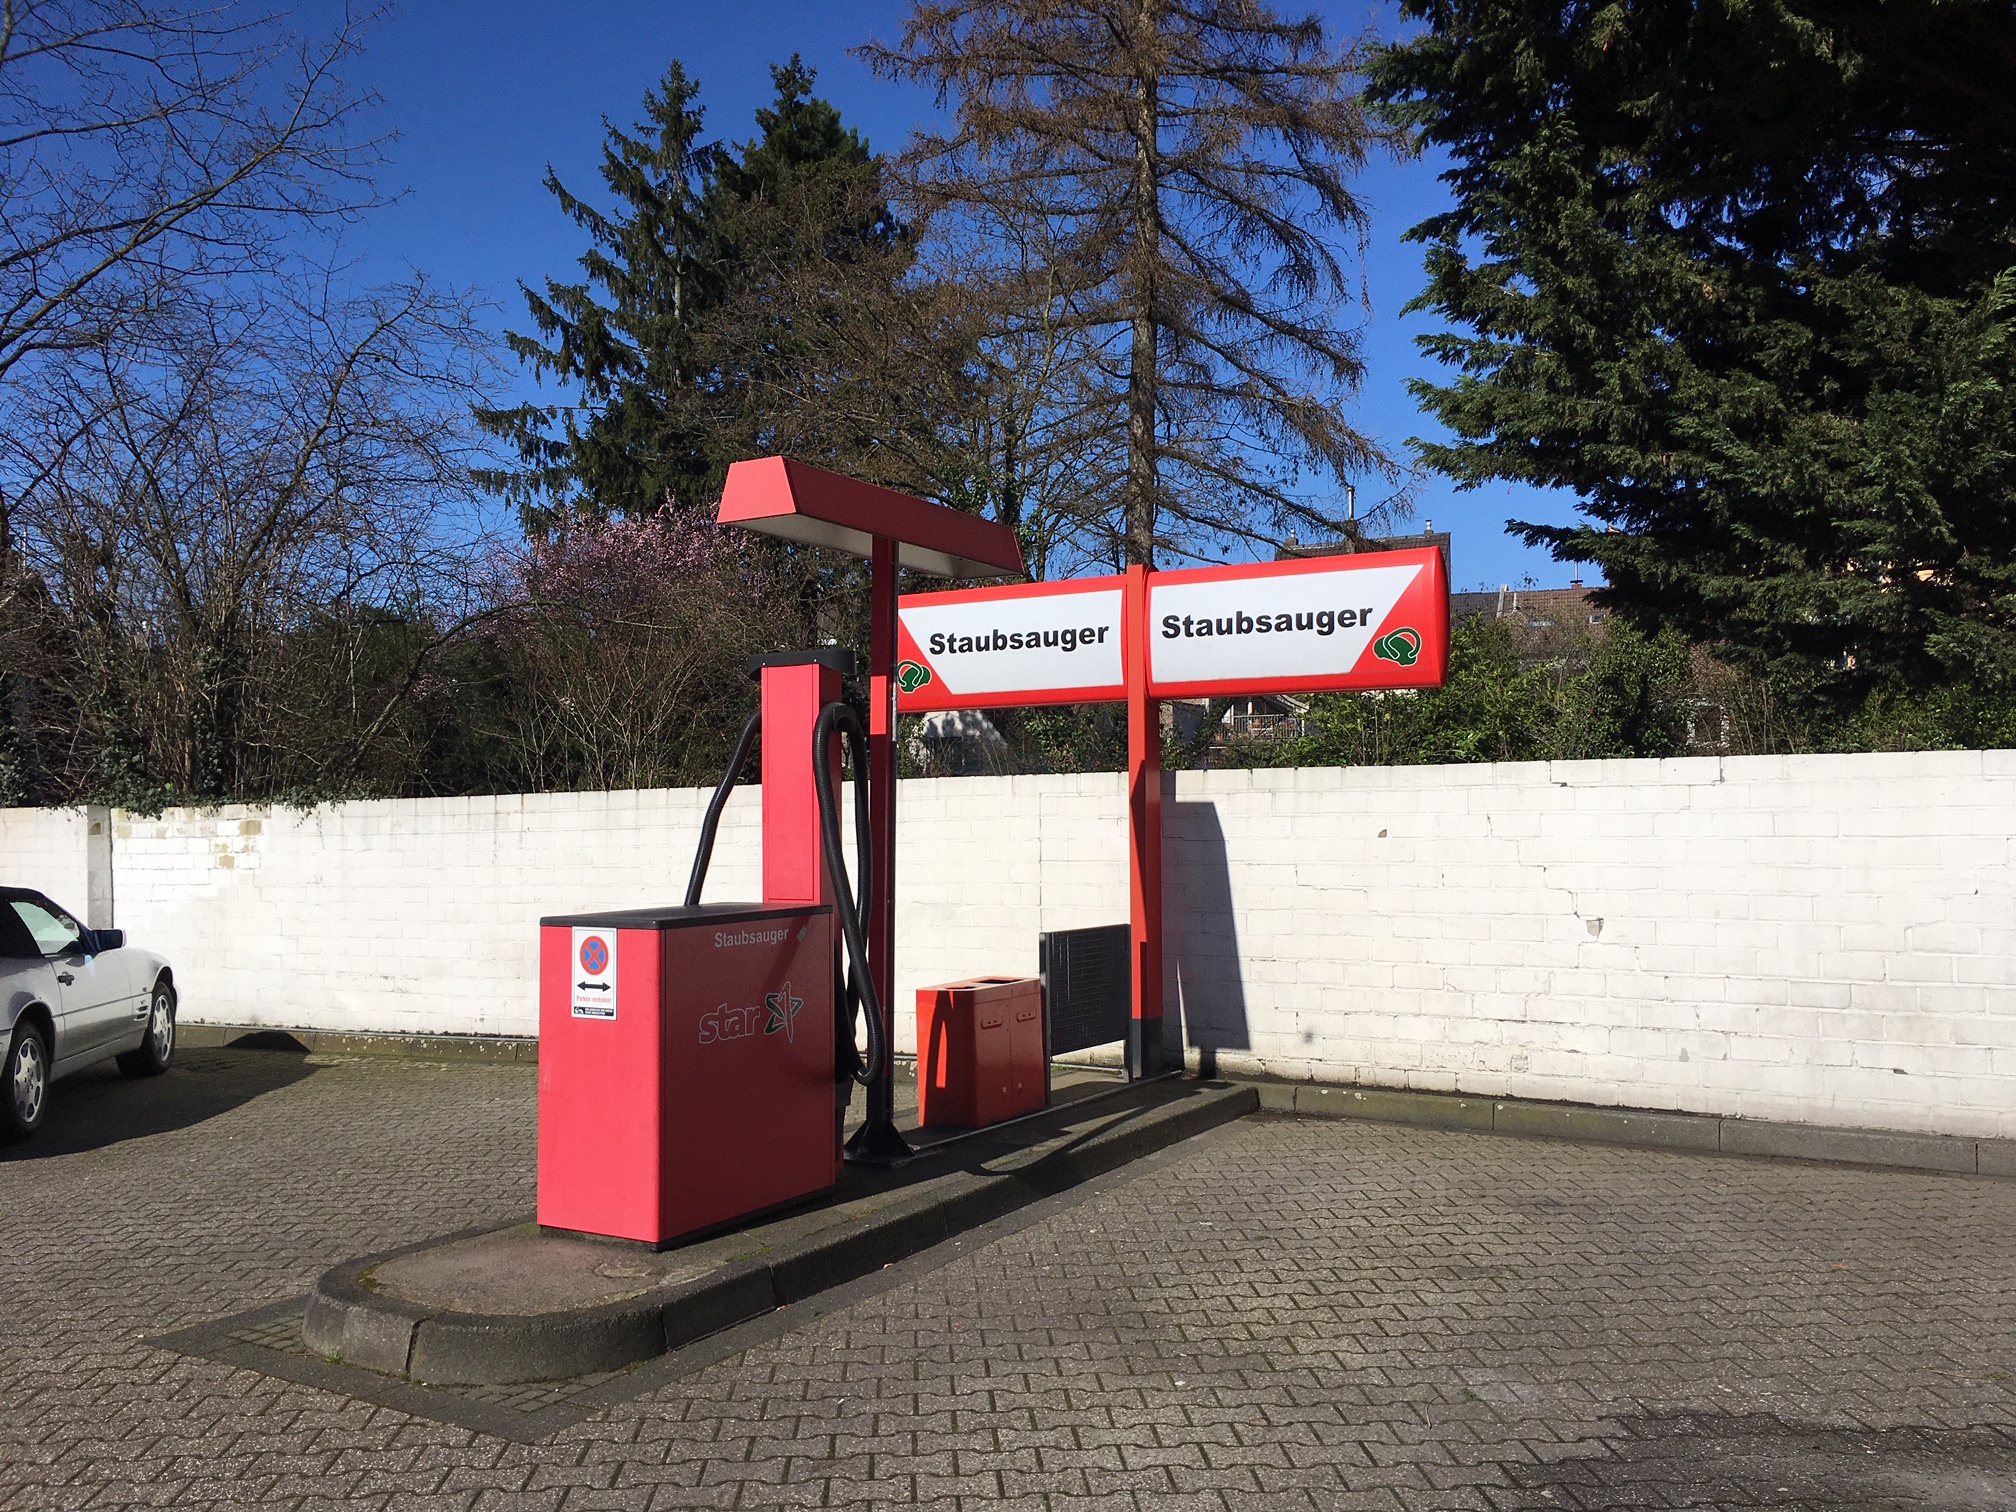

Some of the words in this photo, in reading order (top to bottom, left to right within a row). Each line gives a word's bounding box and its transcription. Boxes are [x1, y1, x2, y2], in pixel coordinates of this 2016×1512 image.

[1161, 607, 1374, 639] Staubsauger
[928, 624, 1110, 655] Staubsauger
[714, 928, 789, 948] Staubsauger
[699, 1002, 761, 1044] star
